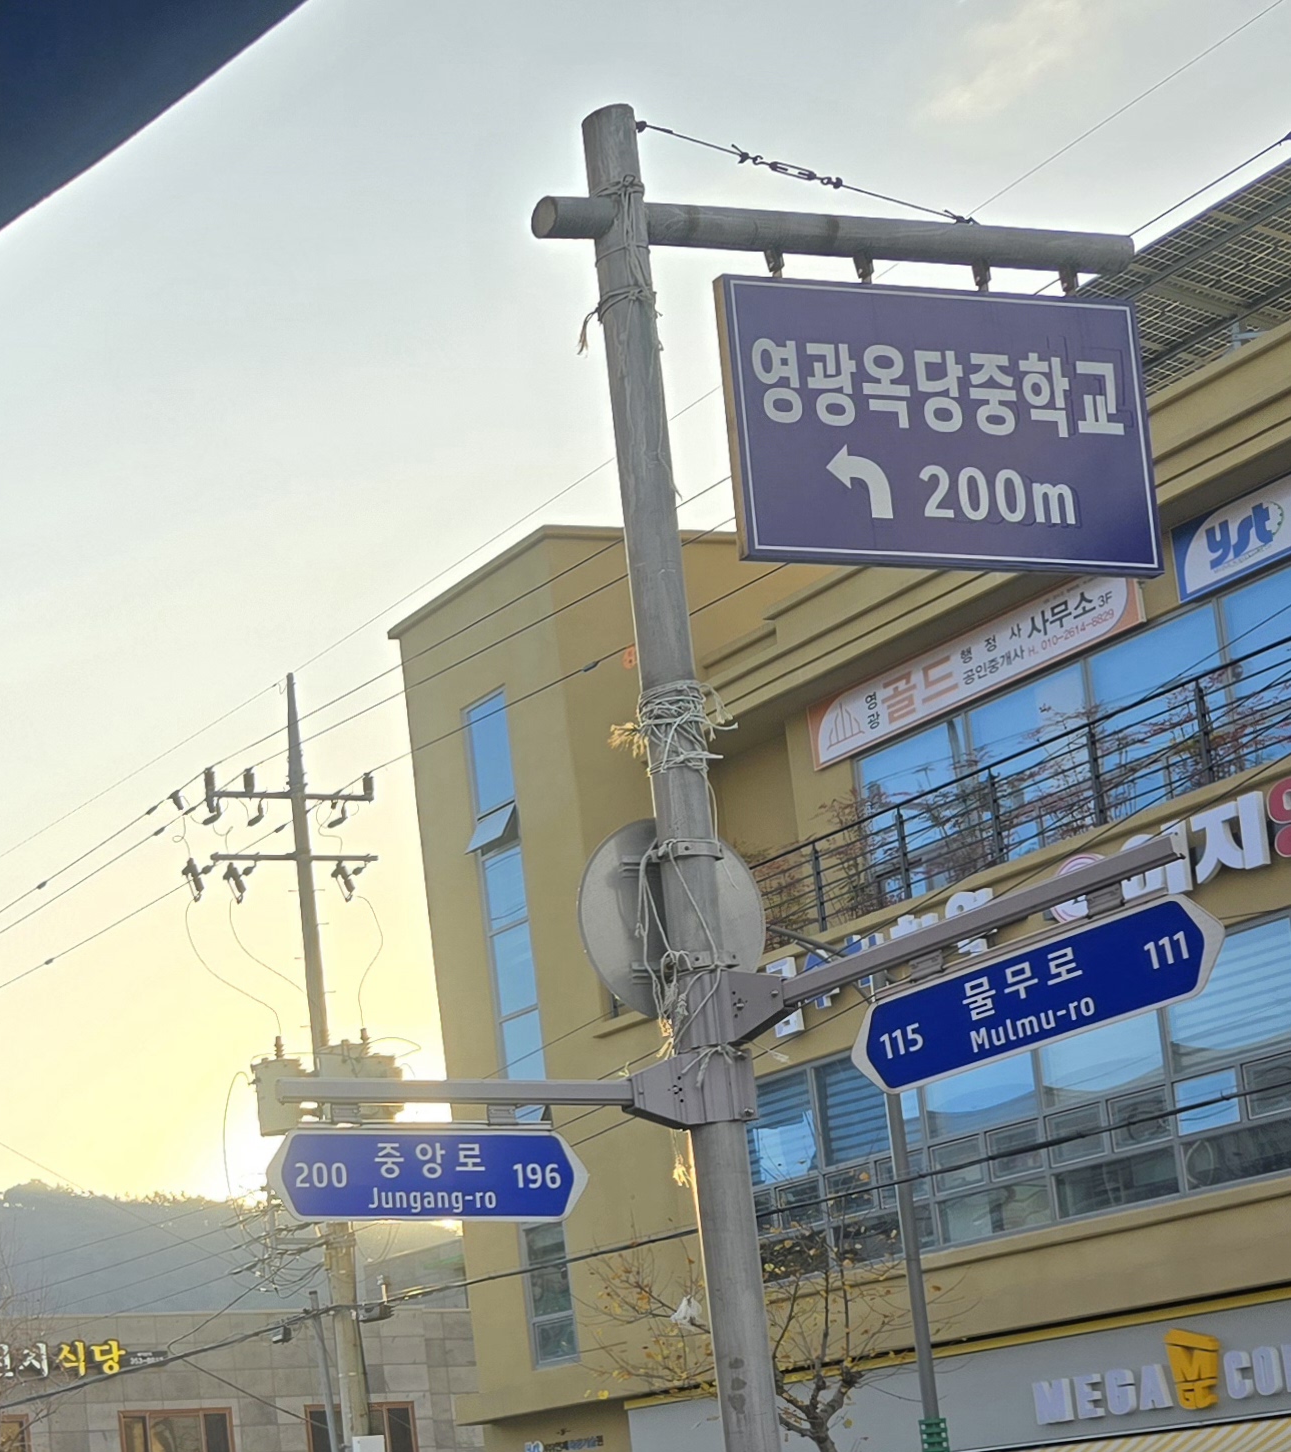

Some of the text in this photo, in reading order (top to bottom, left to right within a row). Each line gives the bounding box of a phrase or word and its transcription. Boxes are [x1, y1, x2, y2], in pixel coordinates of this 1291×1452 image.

[751, 337, 1125, 438] 영광옥당중학교
[918, 465, 1077, 526] 200m
[1027, 592, 1097, 639] 사무소
[881, 655, 958, 724] 골드
[963, 644, 1025, 686] 공인중개사
[880, 931, 1189, 1059] 115 물무로 111
[970, 997, 1095, 1053] Mulmu-ro
[294, 1143, 562, 1189] 200 중앙로 196
[368, 1187, 497, 1213] Jungang-ro
[57, 1340, 126, 1376] 식당
[1032, 1364, 1174, 1425] MEGA
